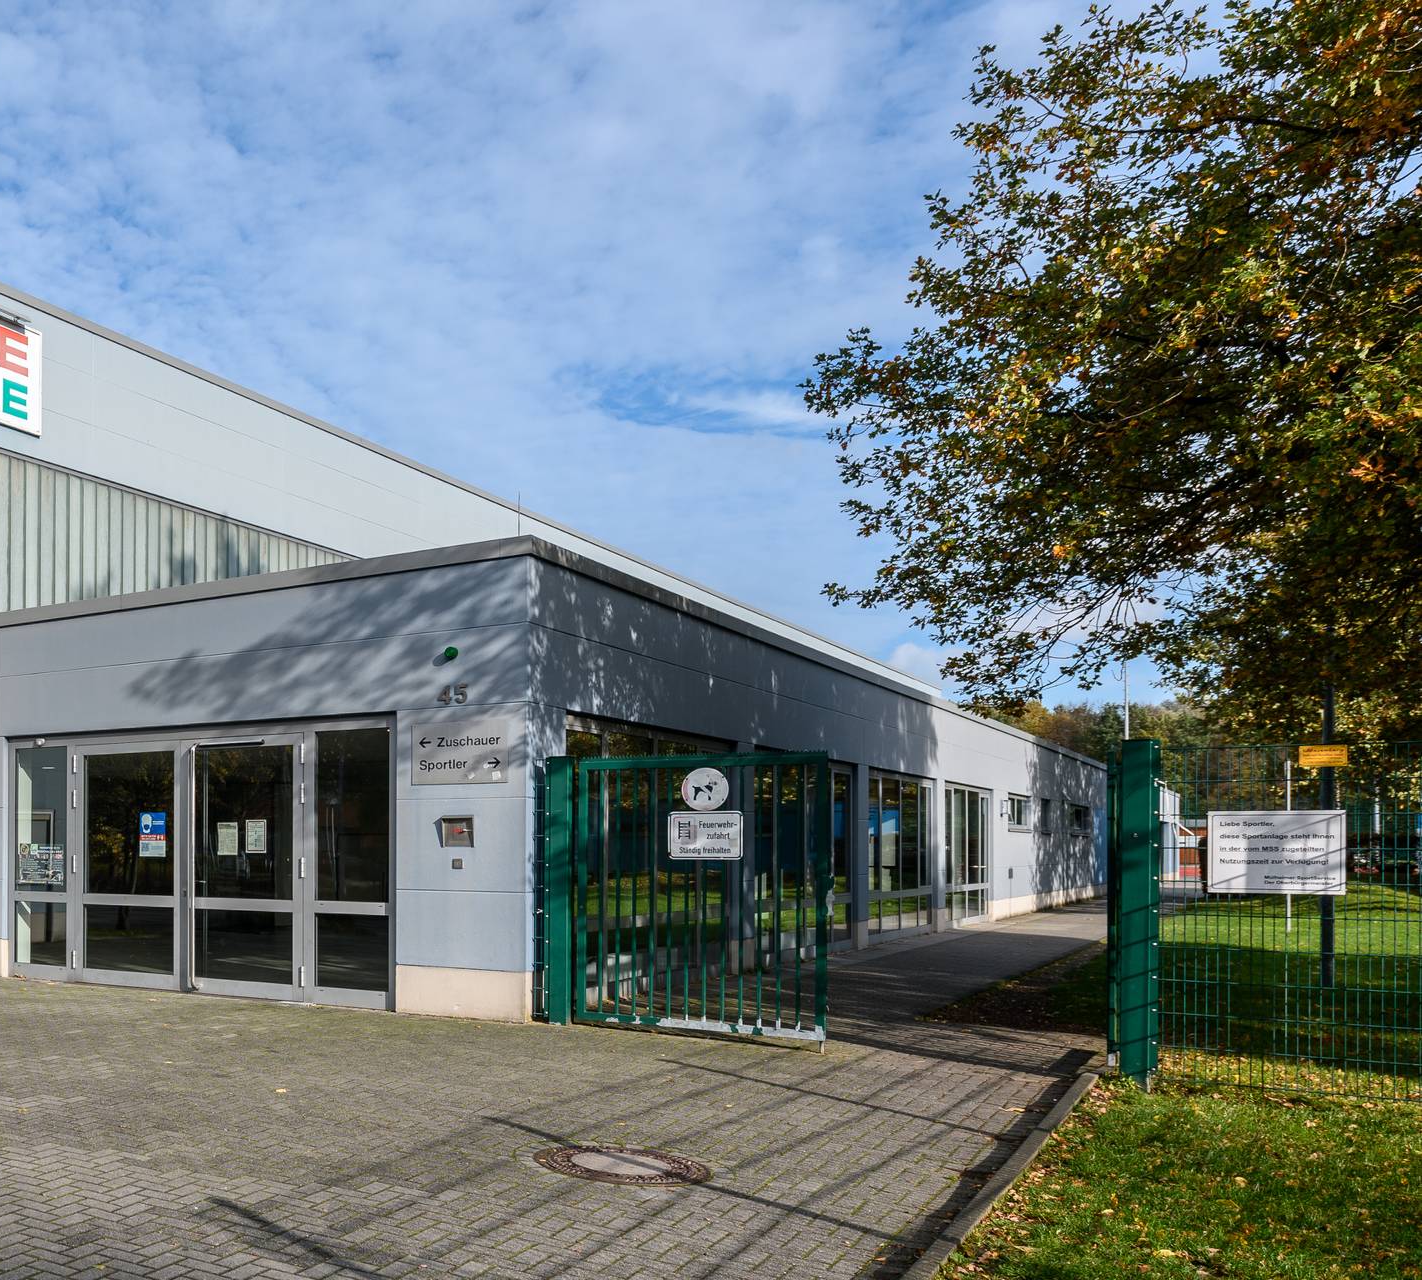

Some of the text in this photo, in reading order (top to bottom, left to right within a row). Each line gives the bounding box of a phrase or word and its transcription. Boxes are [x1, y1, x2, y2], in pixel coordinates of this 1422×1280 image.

[437, 683, 468, 705] 45
[437, 736, 501, 748] Zuschauer
[419, 759, 468, 772] Sportler
[698, 820, 738, 829] Feuerwehr-
[706, 832, 731, 840] zufahrt
[679, 846, 732, 855] Ständig freihalten
[1284, 858, 1329, 866] Verfügung!
